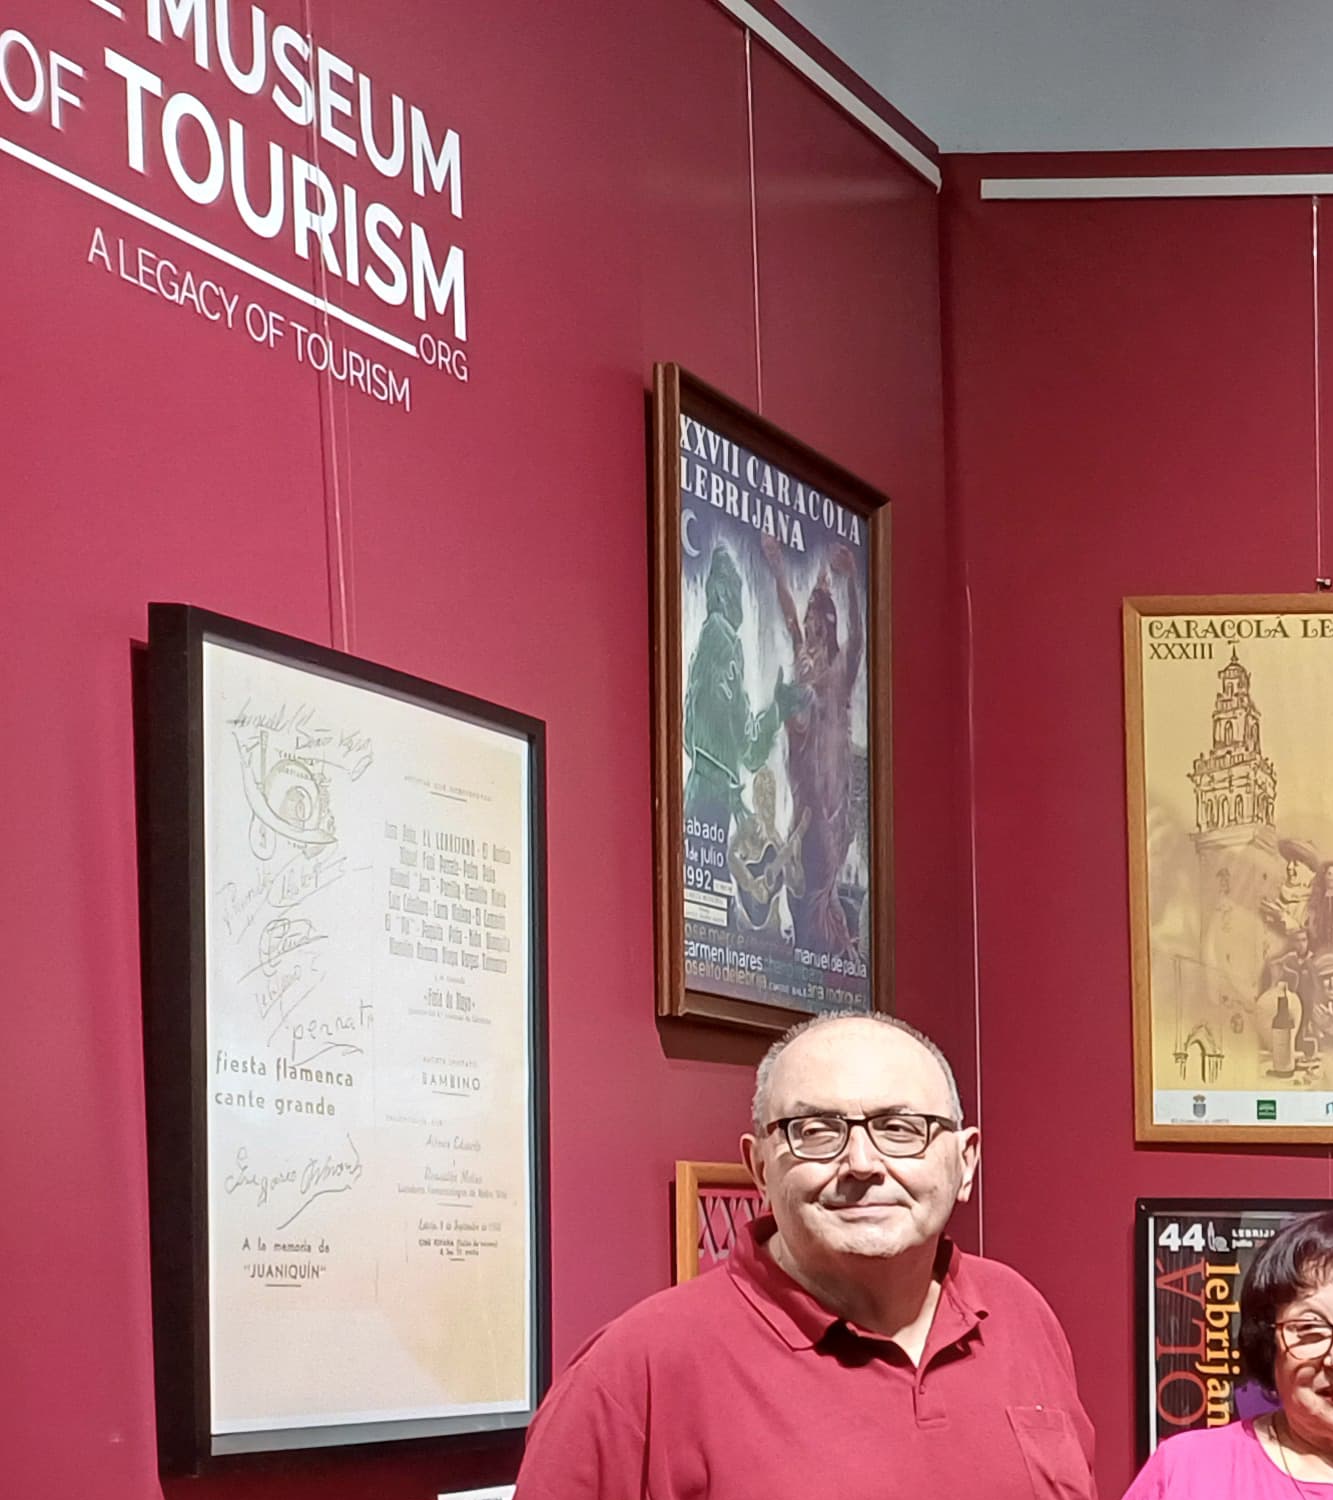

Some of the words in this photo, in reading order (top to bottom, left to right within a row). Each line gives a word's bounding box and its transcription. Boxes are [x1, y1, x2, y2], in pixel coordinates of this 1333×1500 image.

[145, 0, 463, 219] MUSEUM
[0, 29, 87, 131] OF
[103, 47, 468, 341] TOURISM
[88, 227, 112, 272] A
[117, 238, 239, 328] LEGACY
[246, 302, 285, 348] OF
[291, 321, 412, 412] TOURISM
[680, 413, 740, 478] XXVII
[747, 456, 861, 546] CARACOLA
[680, 456, 806, 552] LEBRIJANA
[1149, 642, 1214, 660] XXXIII
[684, 816, 725, 843] abado
[214, 1089, 265, 1109] cante
[275, 1096, 336, 1118] grande
[215, 1050, 266, 1077] fiesta
[276, 1057, 354, 1087] flamenca
[1159, 1223, 1205, 1252] 44
[1195, 1261, 1242, 1427] lebrijan
